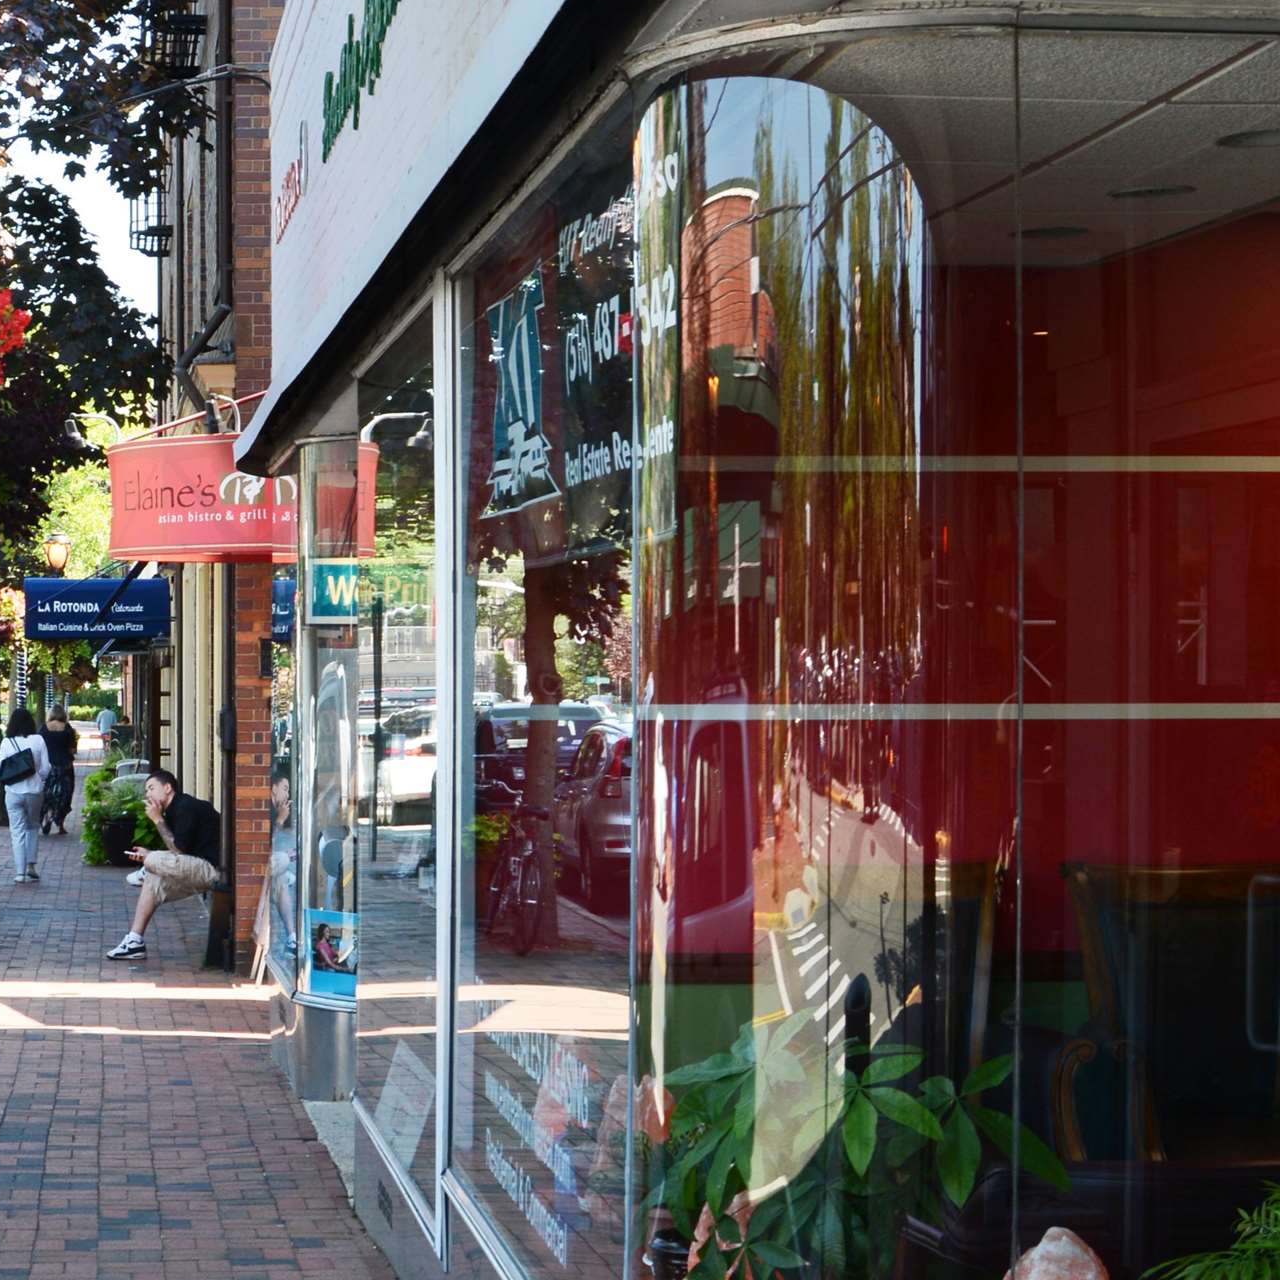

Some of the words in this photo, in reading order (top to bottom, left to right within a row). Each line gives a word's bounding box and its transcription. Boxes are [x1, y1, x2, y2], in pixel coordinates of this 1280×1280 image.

[565, 442, 581, 488] Real
[582, 440, 611, 482] Estate
[123, 471, 217, 512] Elaine's
[187, 511, 222, 523] bistro
[225, 510, 234, 522] &
[239, 509, 268, 524] grill
[53, 600, 100, 613] ROTONDA
[37, 622, 58, 632] Italian
[58, 622, 83, 632] Cuisine
[83, 622, 89, 632] &
[106, 622, 125, 632] Oven
[125, 622, 144, 632] Pizza
